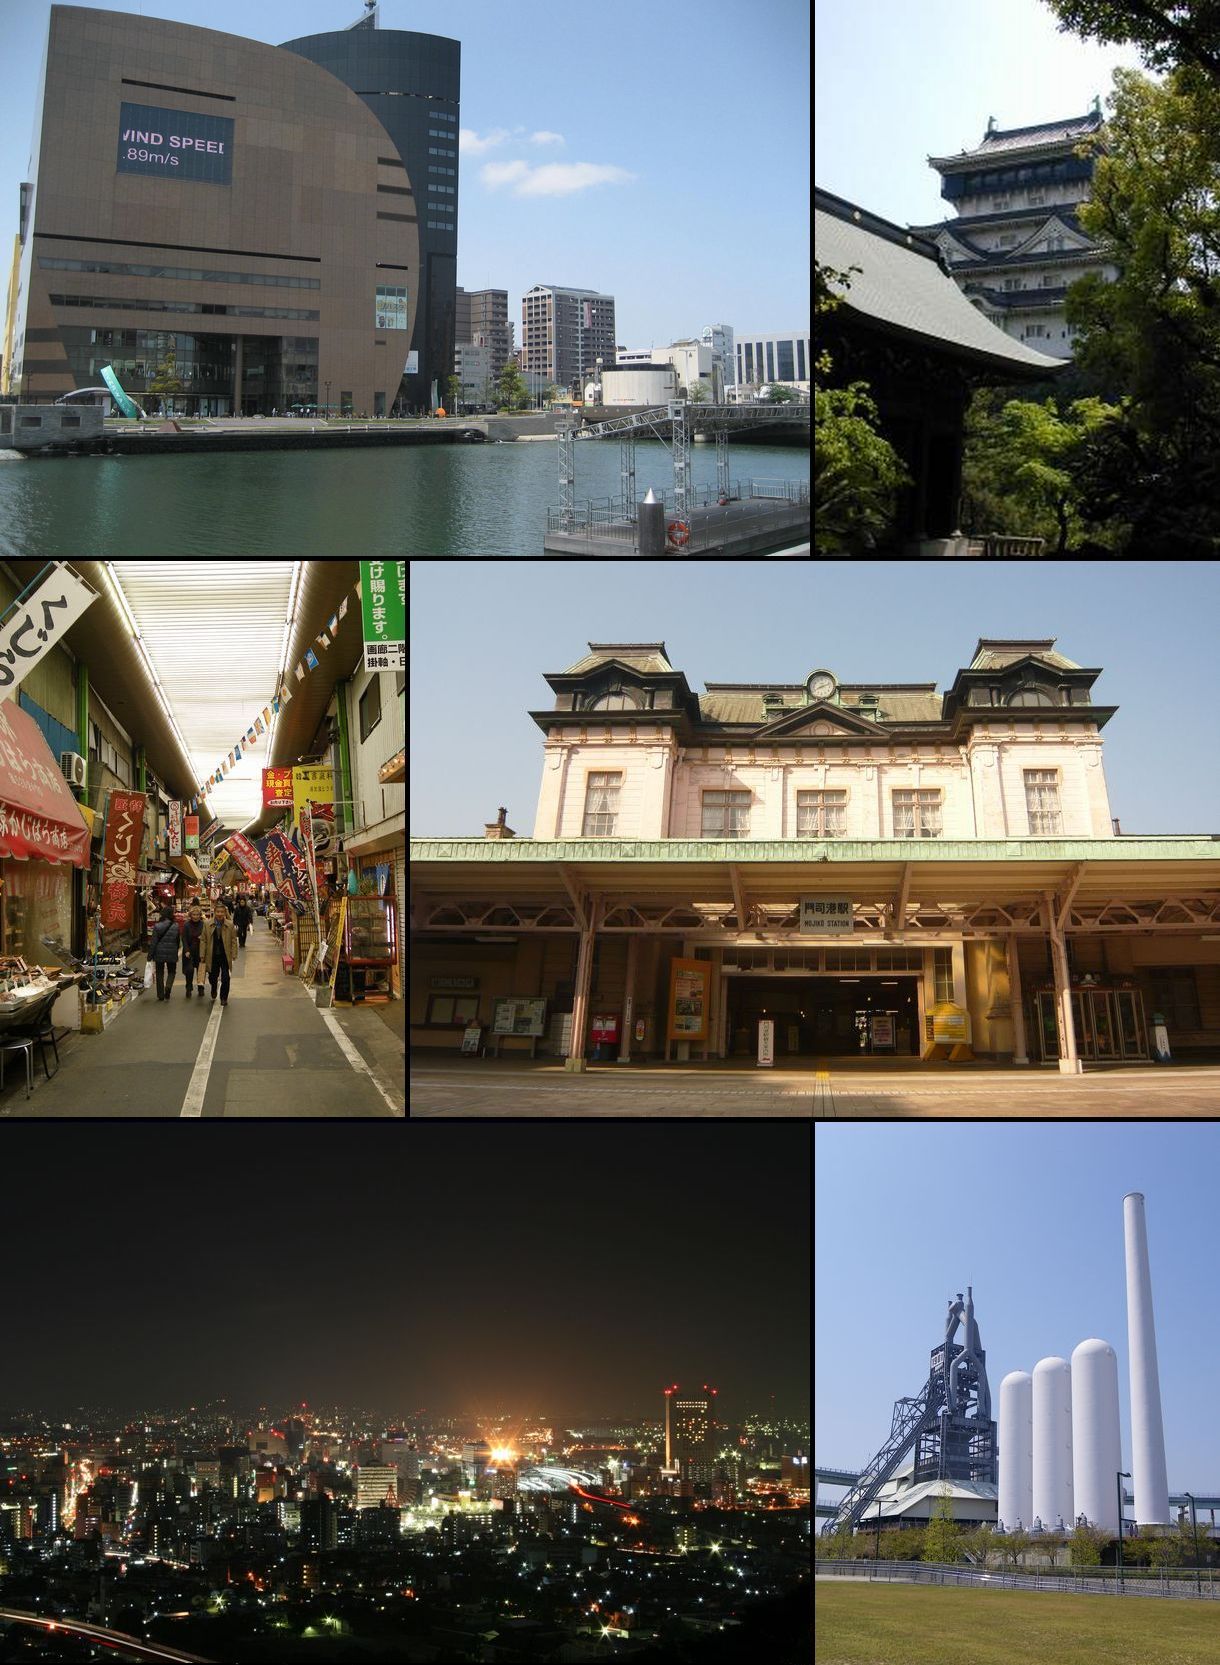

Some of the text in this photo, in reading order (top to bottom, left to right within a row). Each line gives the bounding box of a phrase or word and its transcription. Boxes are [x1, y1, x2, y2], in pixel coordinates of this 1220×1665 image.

[804, 902, 849, 915] 門司港駅
[827, 919, 850, 927] STATION
